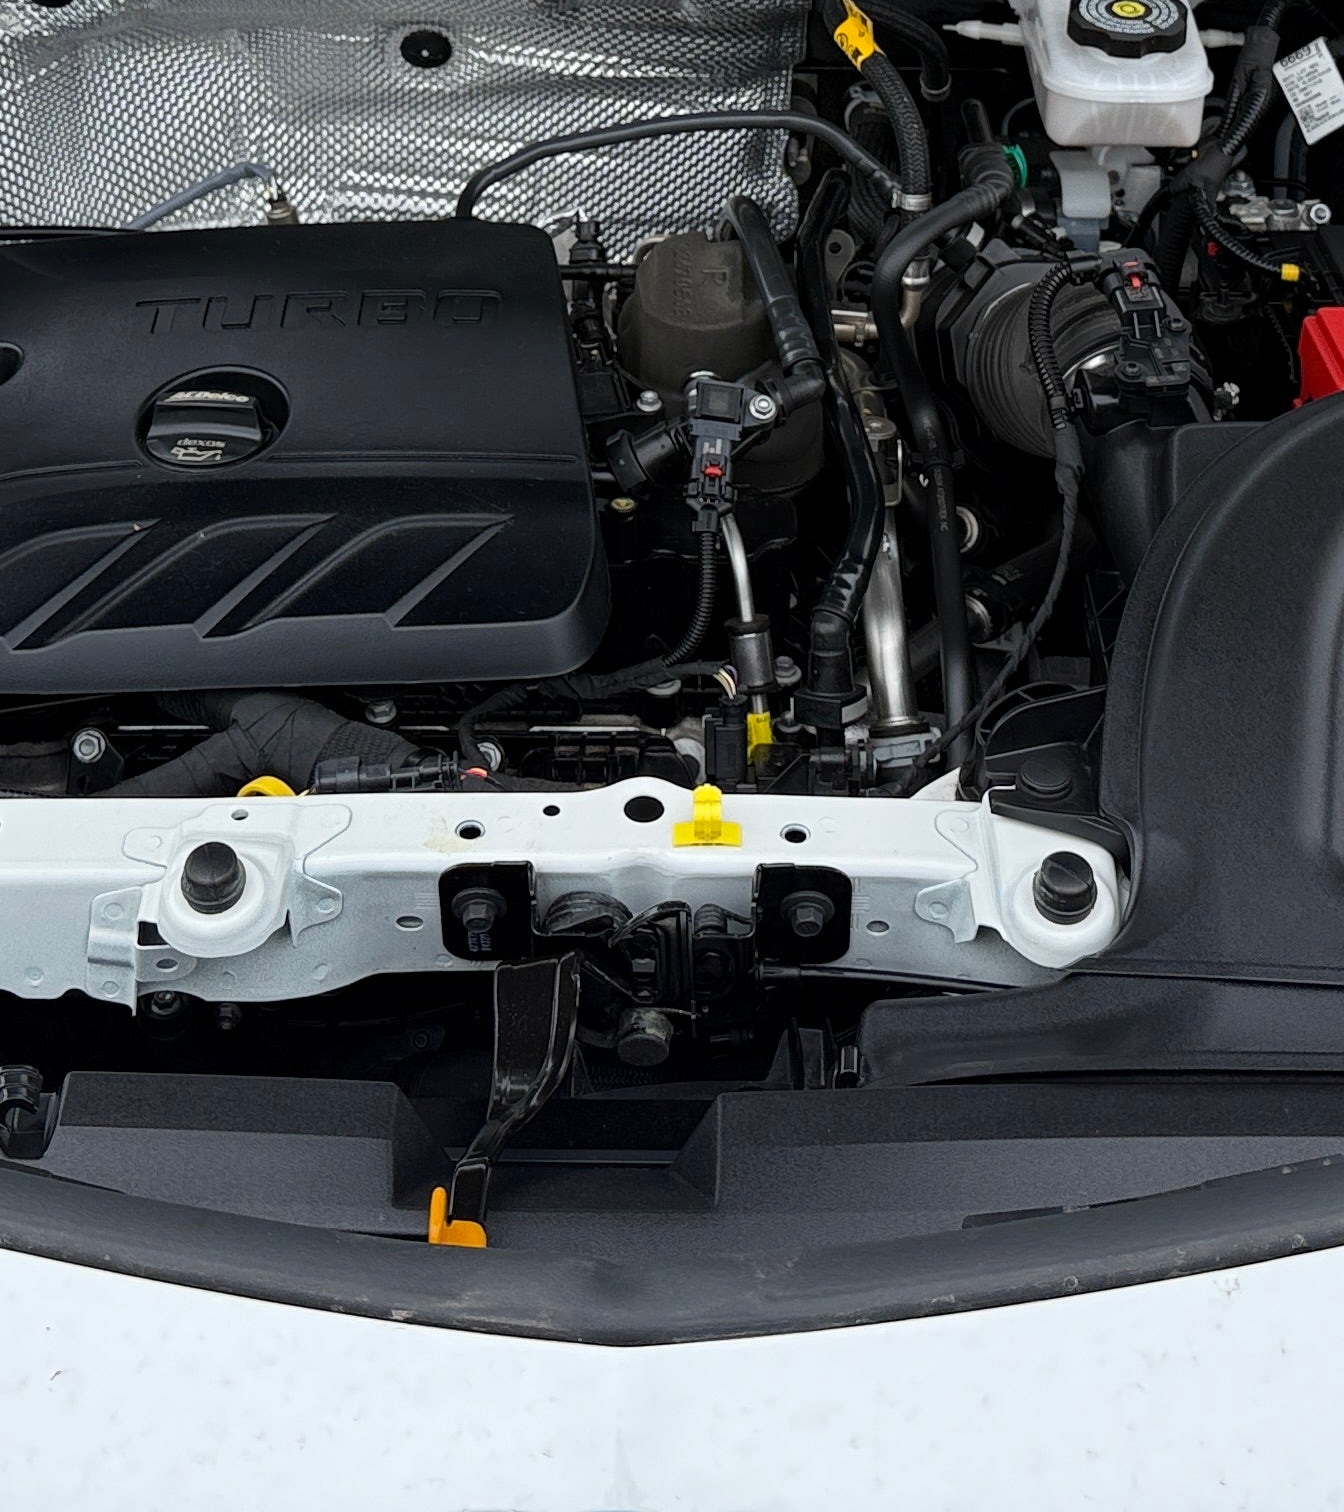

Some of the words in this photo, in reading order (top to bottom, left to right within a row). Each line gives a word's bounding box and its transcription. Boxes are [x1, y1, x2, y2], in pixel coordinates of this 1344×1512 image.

[135, 289, 504, 334] TURBO
[164, 391, 250, 403] ACDelco
[177, 438, 227, 448] dexos
